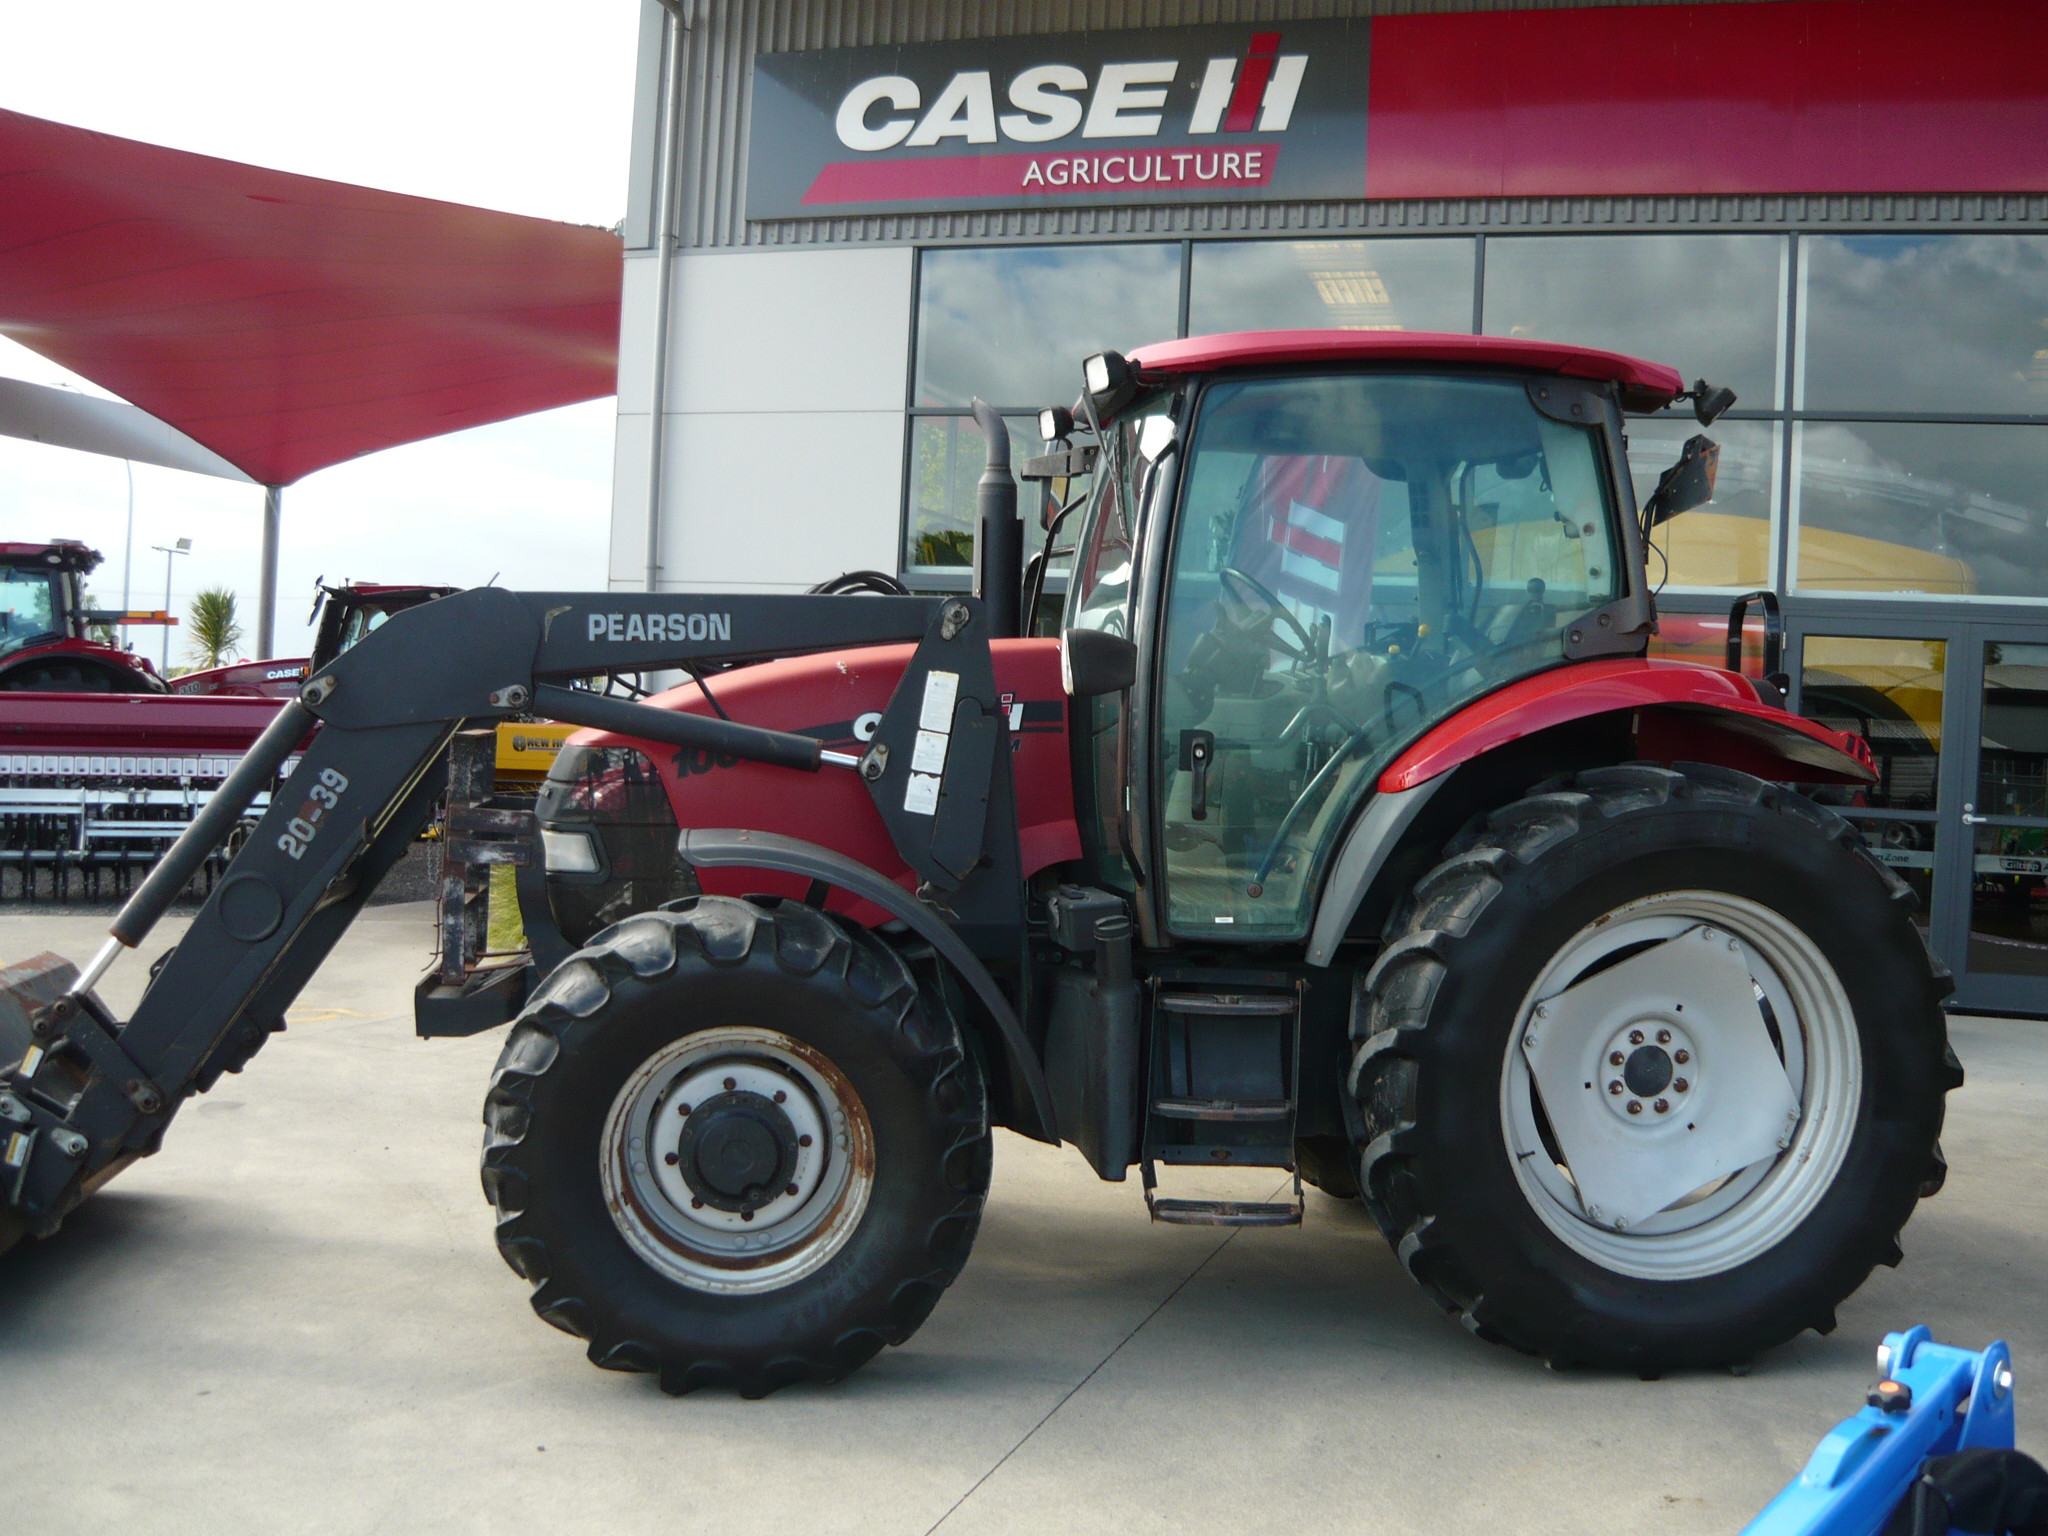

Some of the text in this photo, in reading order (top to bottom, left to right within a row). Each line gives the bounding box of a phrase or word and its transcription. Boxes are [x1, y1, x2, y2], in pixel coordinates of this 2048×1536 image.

[835, 60, 1179, 152] CASE
[1022, 152, 1263, 187] AGRICULTURE
[588, 612, 731, 642] PEARSON
[266, 667, 300, 680] CASE
[278, 767, 348, 860] 20-39
